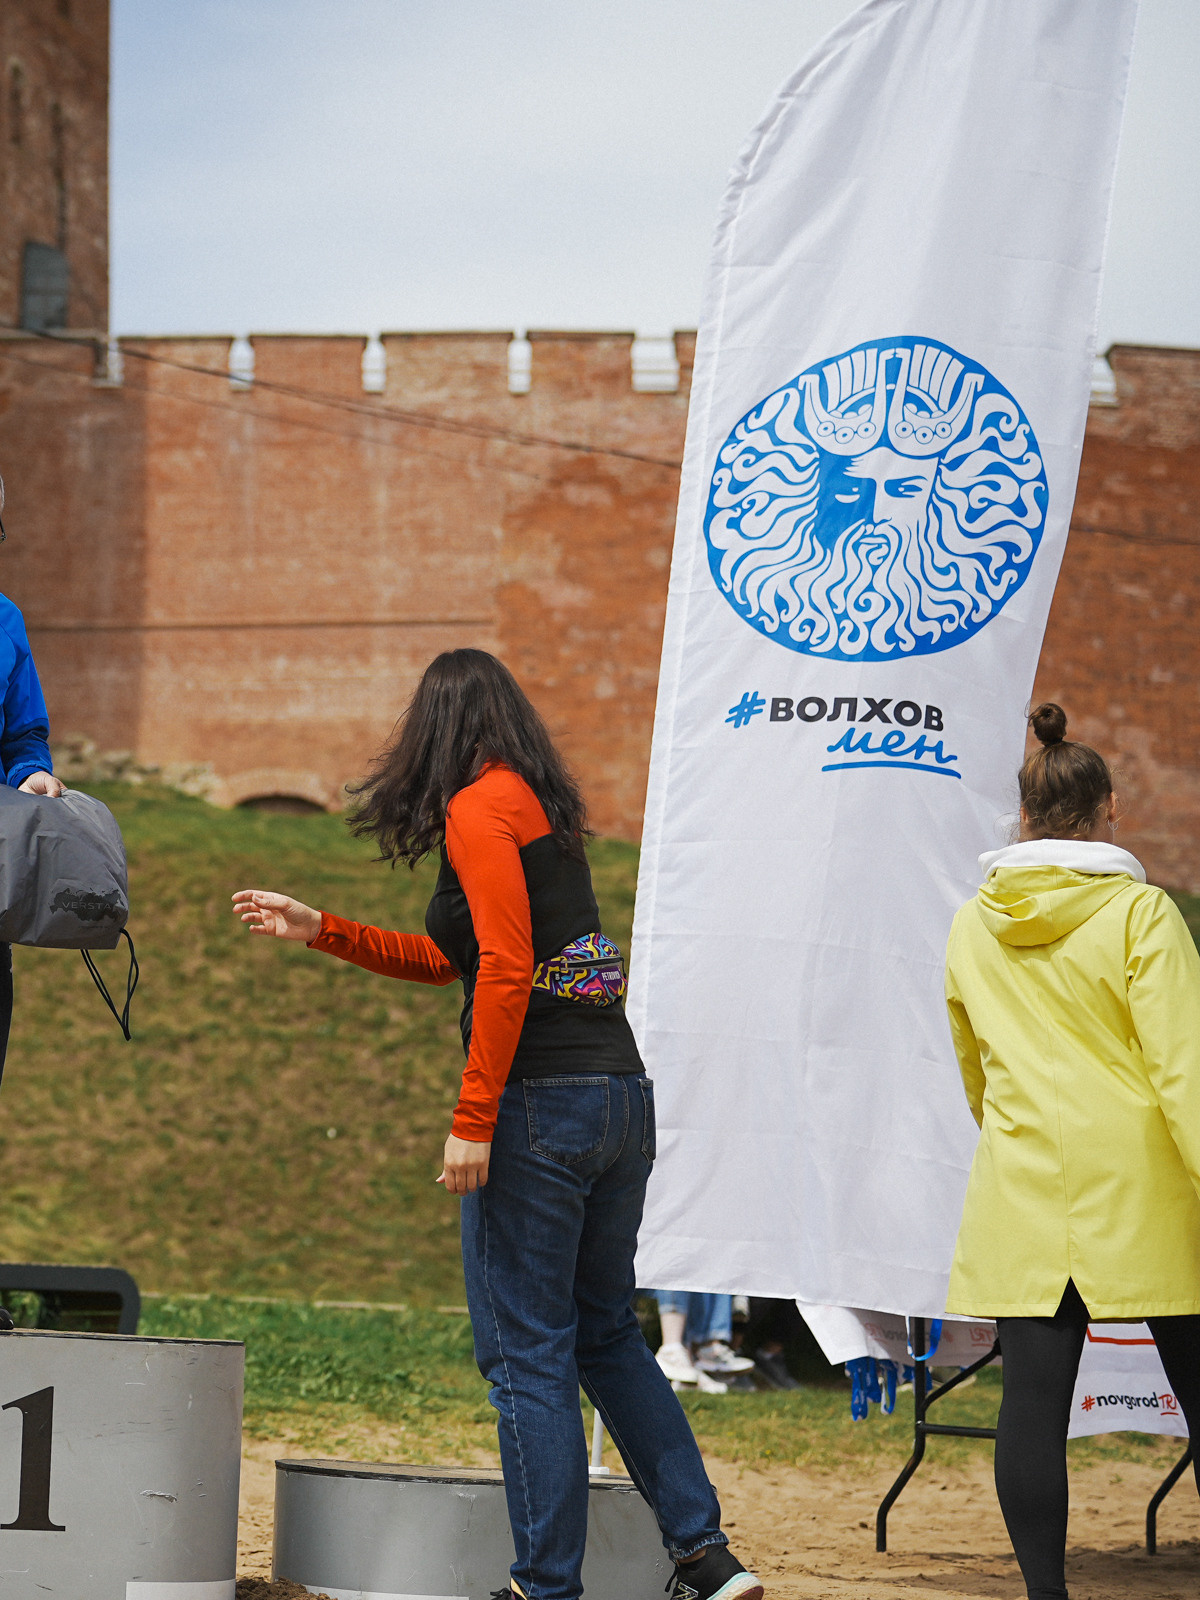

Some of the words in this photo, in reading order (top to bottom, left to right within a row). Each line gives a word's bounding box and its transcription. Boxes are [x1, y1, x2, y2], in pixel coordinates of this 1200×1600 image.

[724, 690, 944, 732] #ВОЛХОВ
[826, 727, 958, 764] мен
[62, 901, 112, 910] VERSTA
[1081, 1391, 1178, 1412] #novgorodTRI
[0, 1385, 66, 1532] 1
